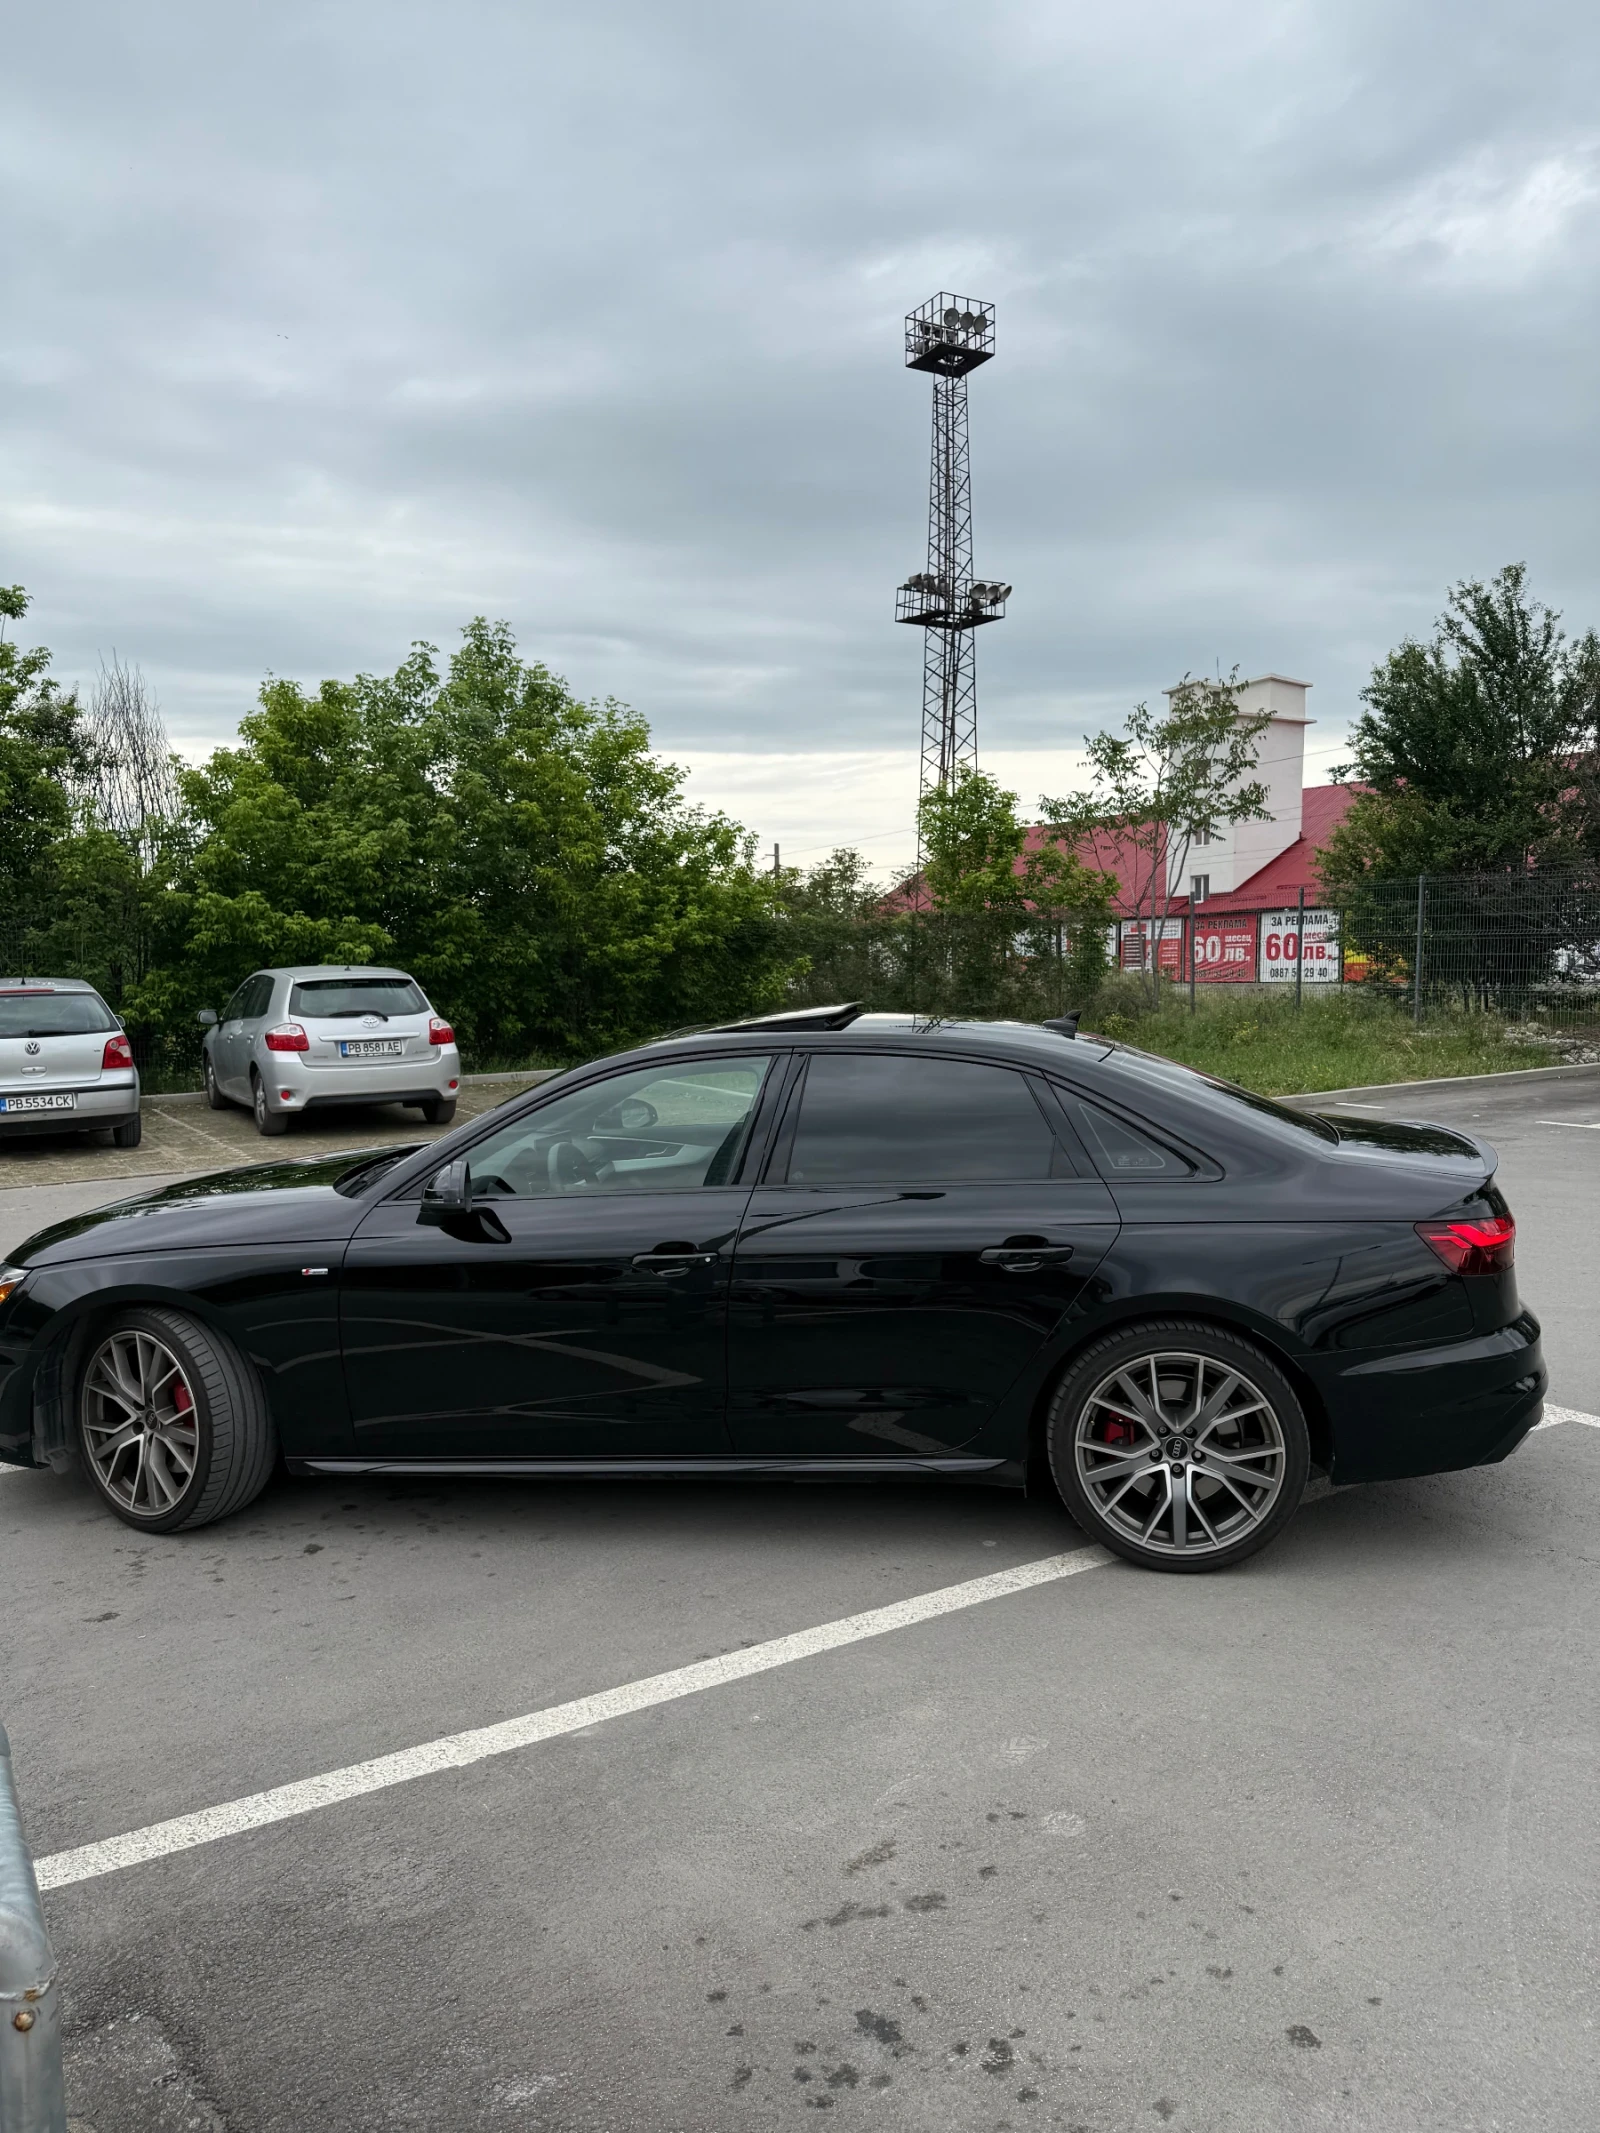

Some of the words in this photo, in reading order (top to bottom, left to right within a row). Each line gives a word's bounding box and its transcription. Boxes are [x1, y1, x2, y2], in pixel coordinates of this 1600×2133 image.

[1271, 916, 1282, 927] ЗА
[1285, 914, 1329, 926] РЕЛАМА
[1303, 931, 1330, 940] месе
[1266, 932, 1299, 961] 60
[1304, 967, 1314, 978] 29
[1318, 967, 1328, 977] 40
[348, 1043, 361, 1053] PB
[363, 1042, 385, 1052] 8581
[387, 1041, 400, 1051] AE
[25, 1096, 54, 1108] 5534
[55, 1095, 71, 1107] CK
